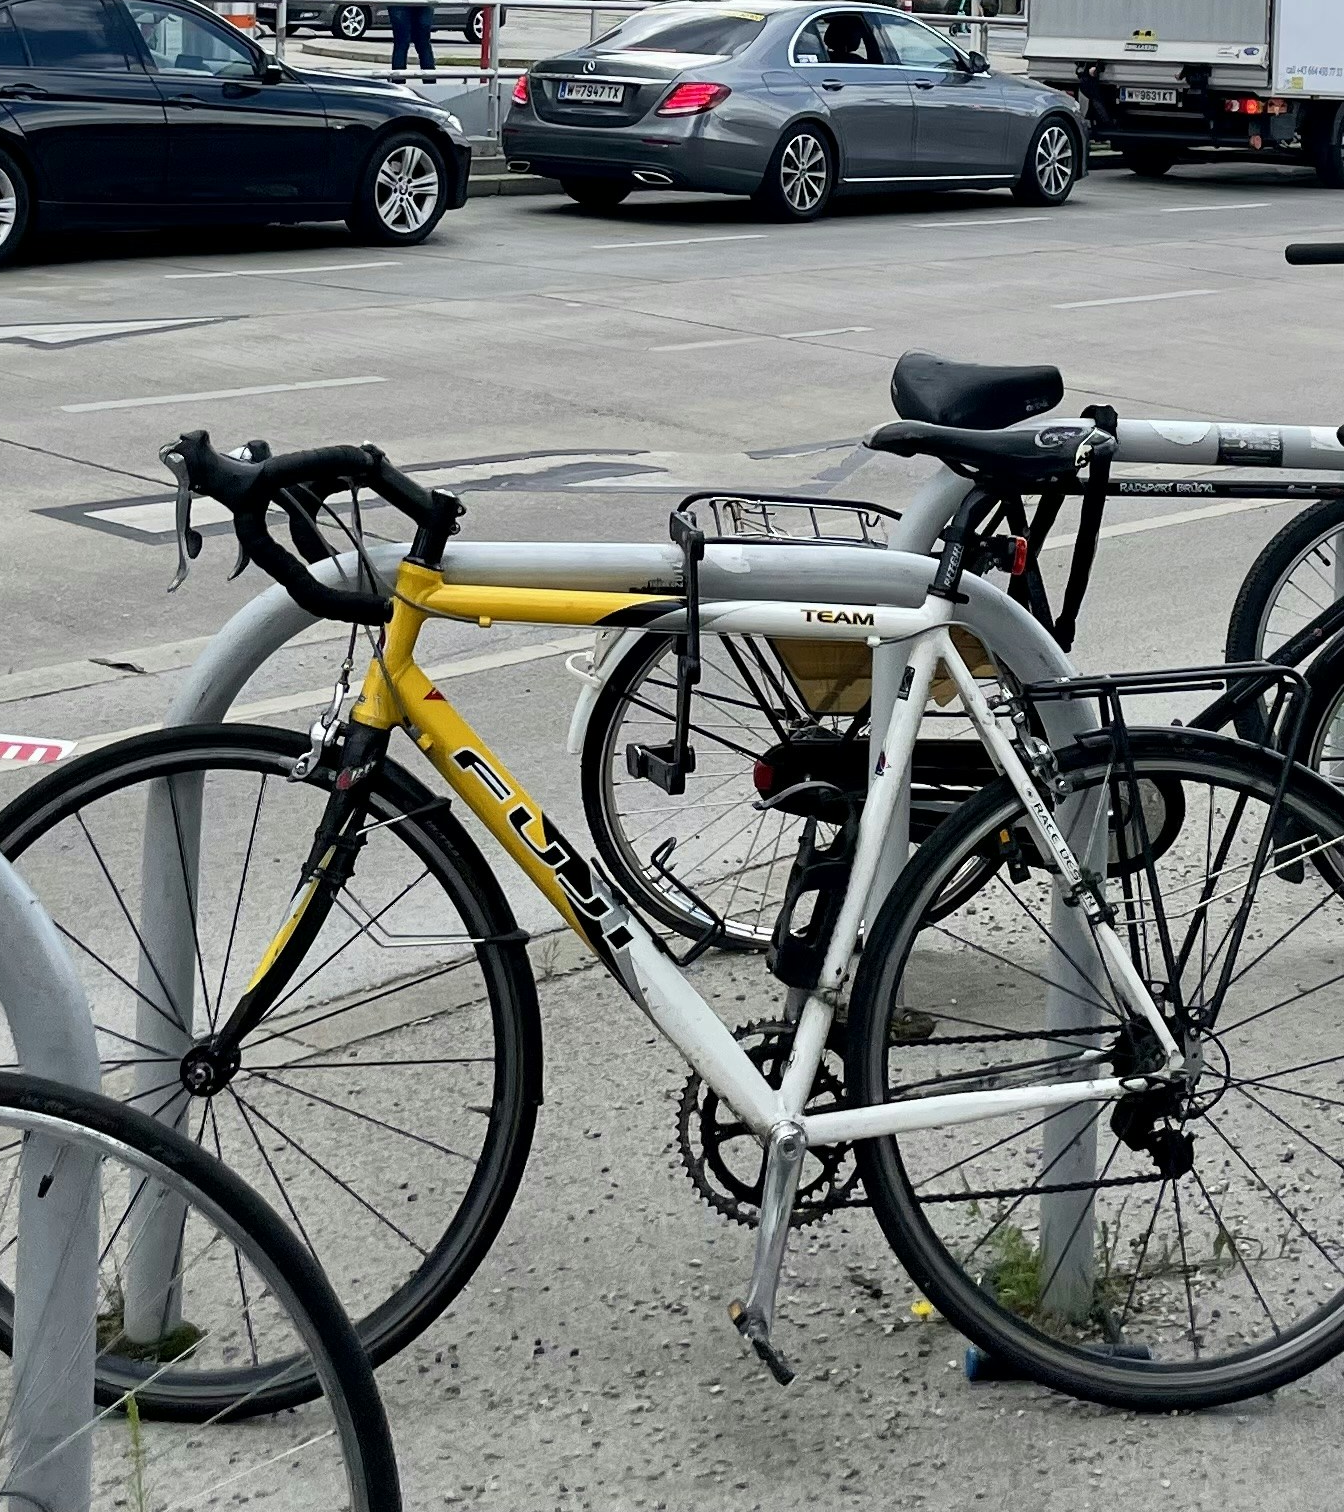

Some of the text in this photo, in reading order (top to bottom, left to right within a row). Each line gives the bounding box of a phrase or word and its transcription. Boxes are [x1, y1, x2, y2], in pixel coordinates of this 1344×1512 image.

[567, 84, 575, 96] W
[1119, 482, 1173, 494] RADSPORT
[800, 608, 875, 626] TEAM
[1033, 802, 1062, 841] RACE
[449, 746, 634, 952] FUJI
